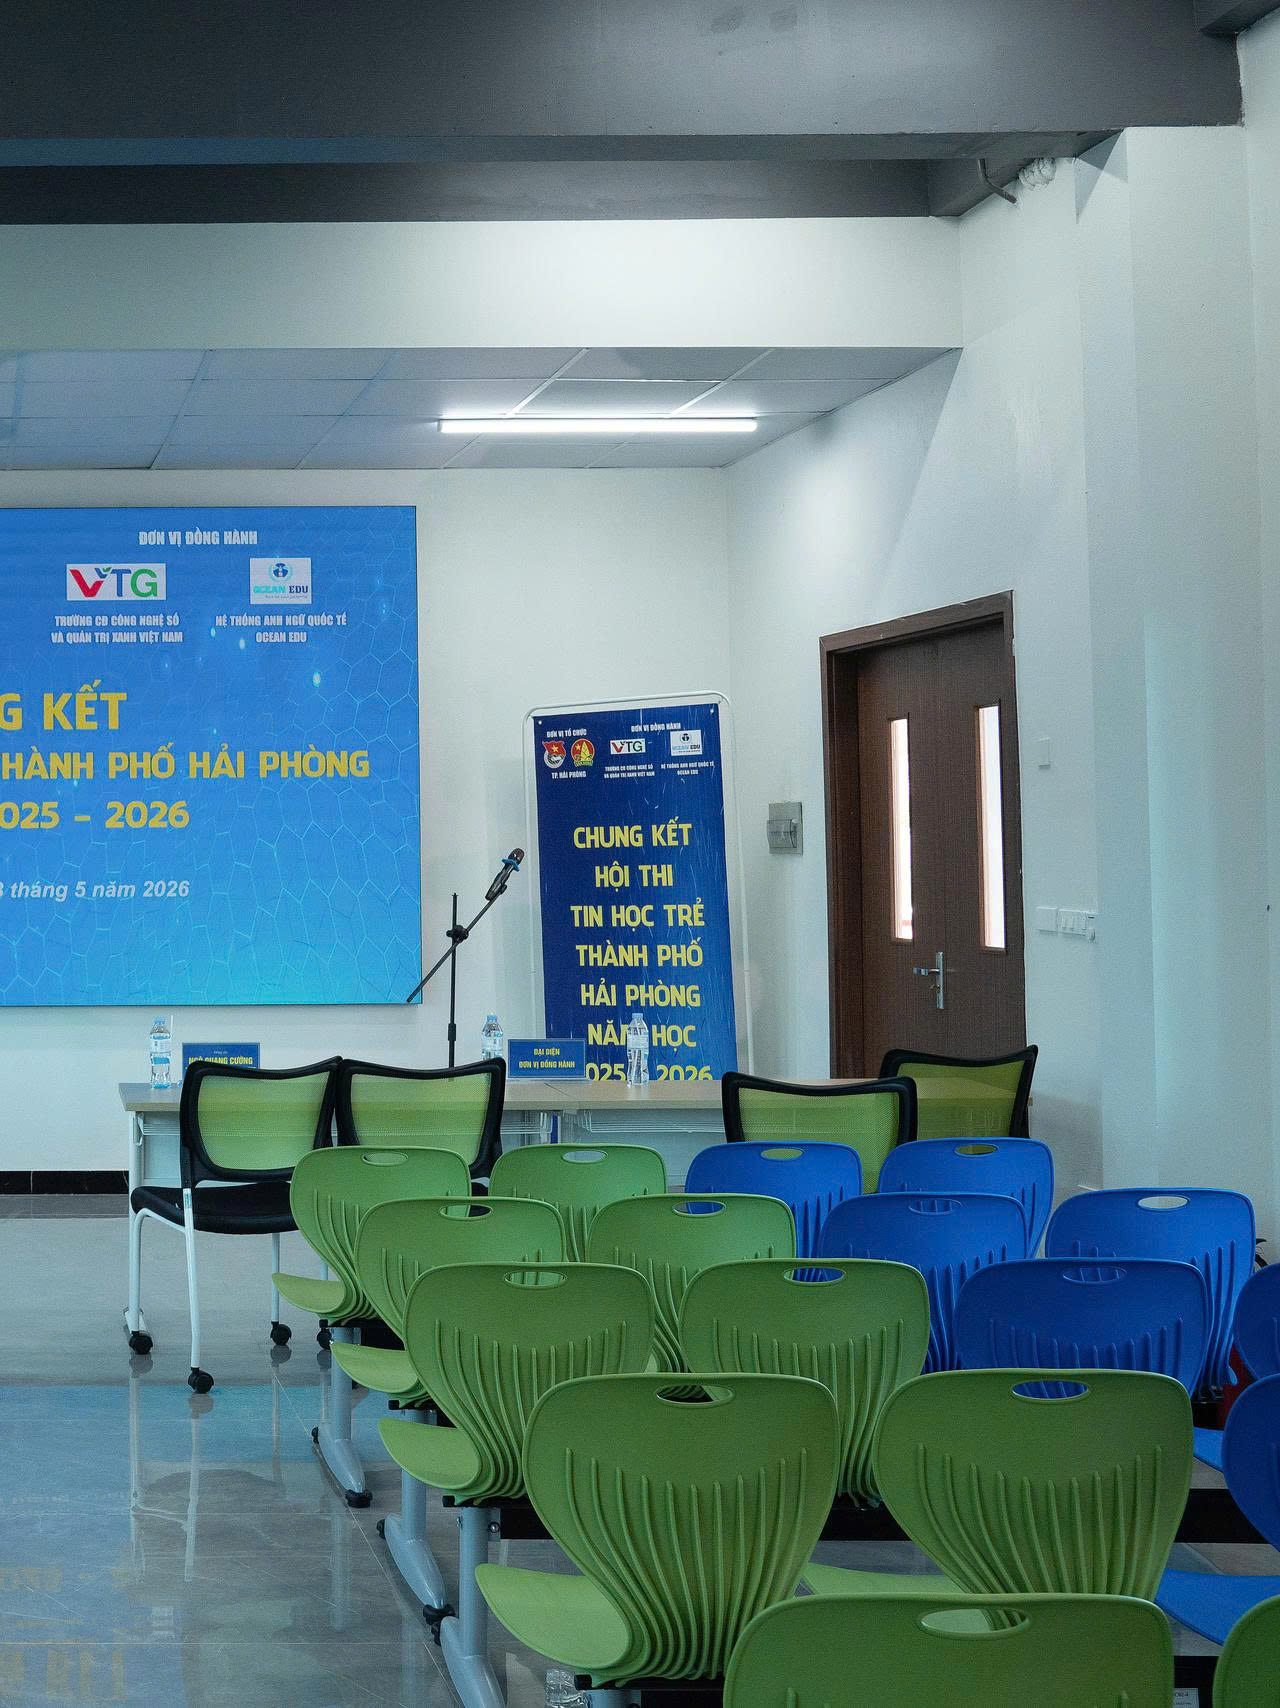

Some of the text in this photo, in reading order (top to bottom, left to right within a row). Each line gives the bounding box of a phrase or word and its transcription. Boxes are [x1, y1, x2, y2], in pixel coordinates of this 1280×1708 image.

[139, 526, 258, 547] ĐƠN VỊ ĐỒNG HÀNH
[70, 567, 158, 598] VTG
[289, 585, 309, 594] EDU
[111, 613, 136, 626] CÔNG
[139, 613, 164, 628] NGHỆ
[216, 613, 227, 628] HỆ
[264, 615, 282, 626] ANH
[51, 630, 64, 644] VÀ
[94, 631, 109, 645] TRỊ
[139, 630, 159, 645] VIỆT
[162, 631, 183, 643] NAM
[256, 631, 307, 643] OCEAN EDU
[43, 679, 128, 731] KẾT
[611, 741, 642, 753] VTG
[109, 742, 176, 779] PHỐ
[189, 742, 245, 779] HẢI
[259, 743, 370, 778] PHÒNG
[105, 800, 190, 829] 2026
[573, 816, 692, 849] CHUNG KẾT
[595, 861, 673, 892] HỘI THI
[10, 880, 69, 903] tháng
[74, 881, 86, 898] 5
[92, 881, 136, 898] năm
[142, 880, 190, 897] 2026
[570, 897, 705, 931] TIN HỌC TRẺ
[575, 937, 703, 967] THÀNH PHỐ
[580, 978, 701, 1007] HẢI PHÒNG
[652, 1025, 696, 1051] HỌC
[585, 1063, 626, 1080] 025
[656, 1064, 713, 1080] 2026
